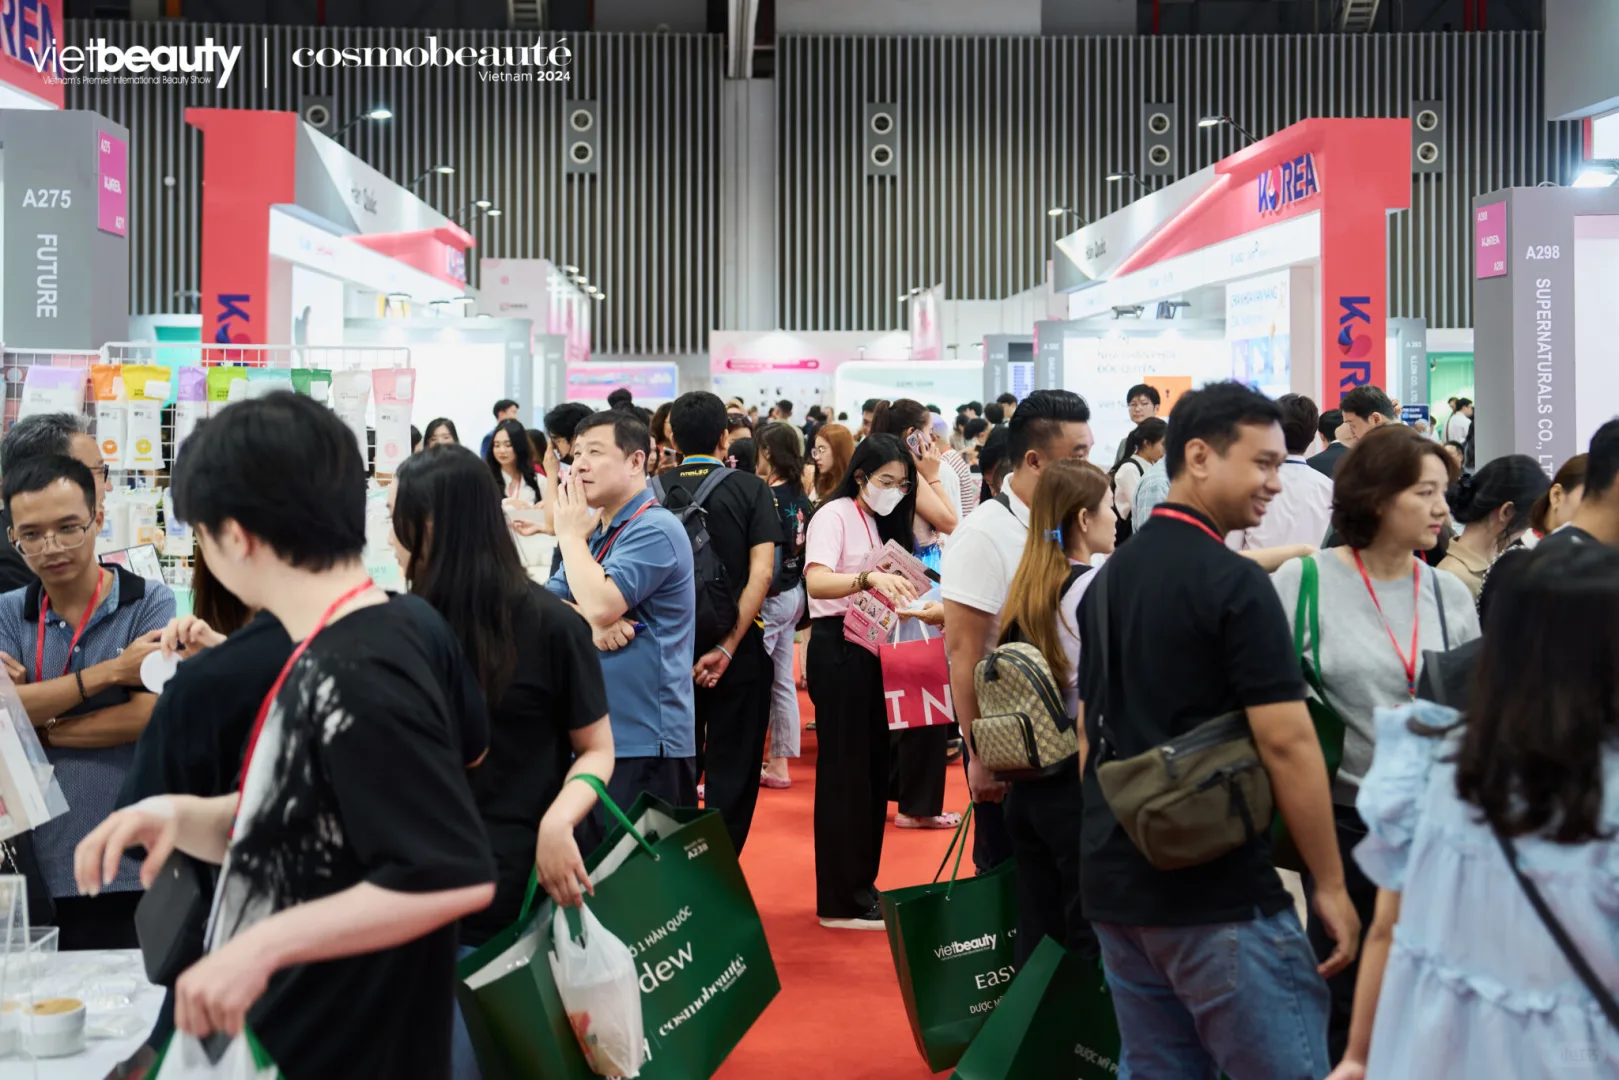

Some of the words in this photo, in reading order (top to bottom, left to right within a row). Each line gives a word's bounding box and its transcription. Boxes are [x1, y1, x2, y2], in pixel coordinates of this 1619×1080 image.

[22, 188, 72, 209] A275
[1258, 152, 1320, 213] KOREA
[1525, 245, 1560, 260] A298
[36, 234, 58, 318] FUTURE
[1536, 278, 1553, 414] SUPERNATURALS
[1536, 418, 1553, 449] CO.,
[644, 926, 668, 947] HÀN
[666, 905, 692, 932] QUỐC
[934, 932, 997, 959] vietbeauty
